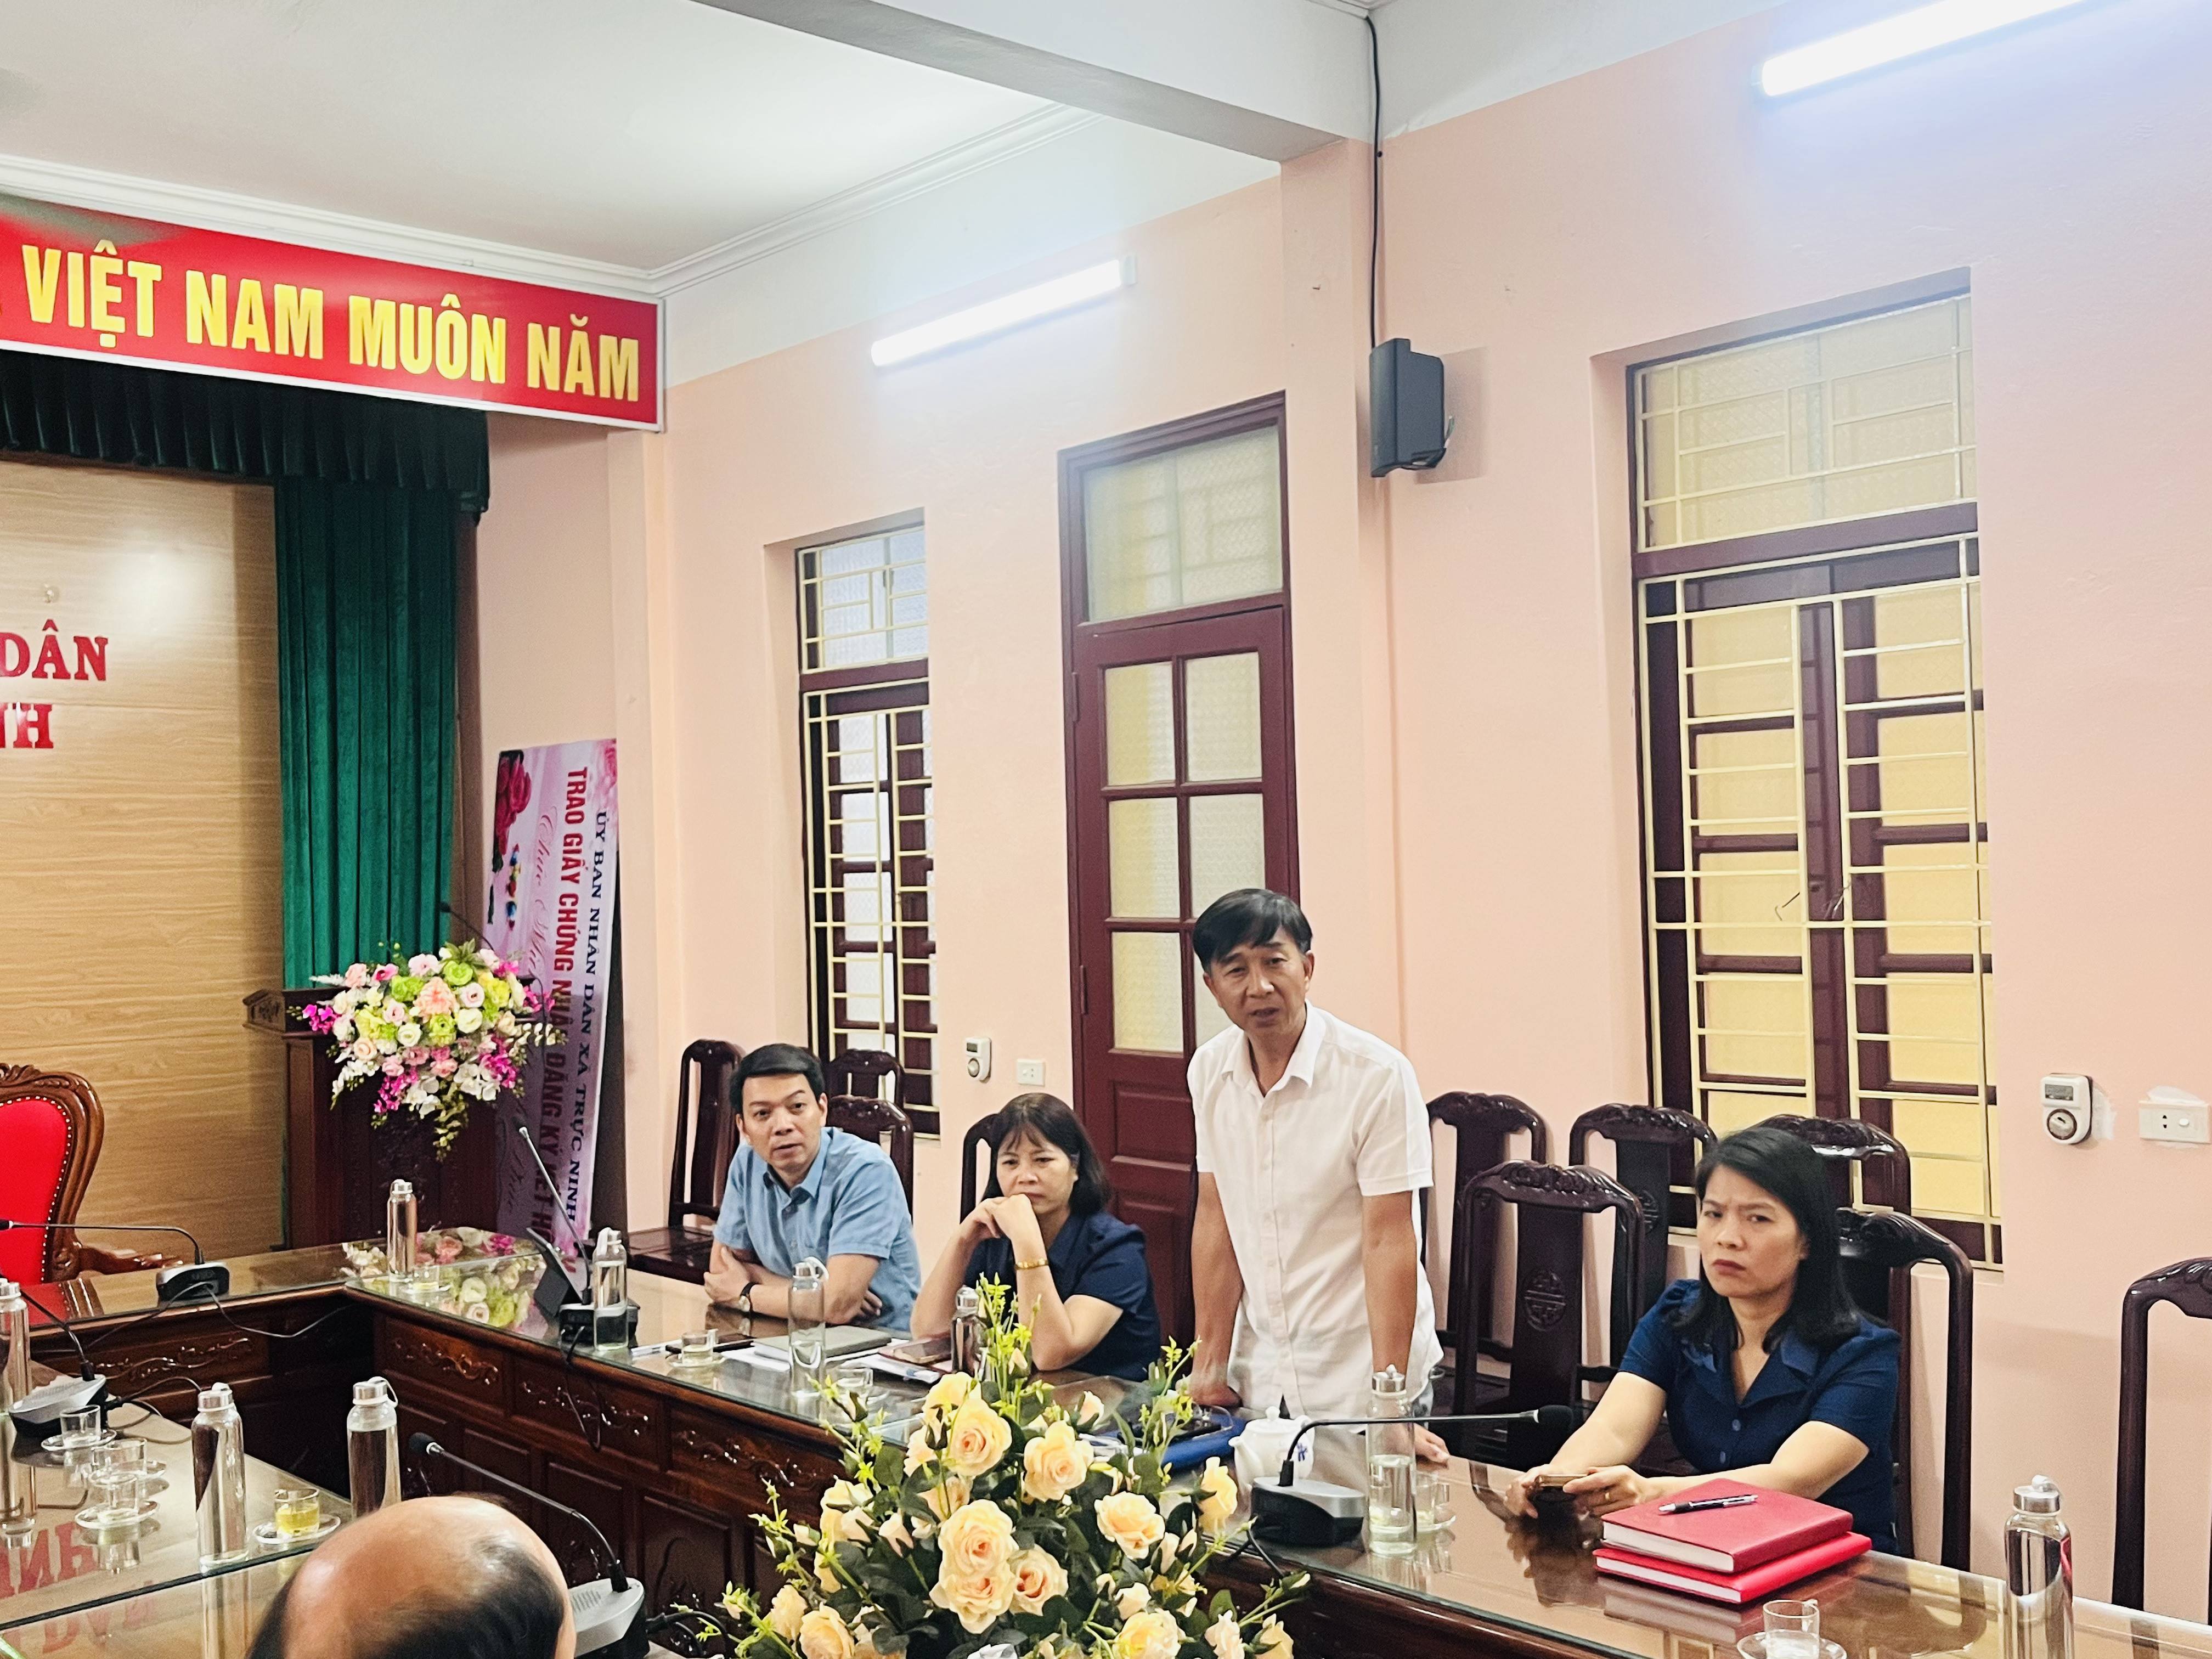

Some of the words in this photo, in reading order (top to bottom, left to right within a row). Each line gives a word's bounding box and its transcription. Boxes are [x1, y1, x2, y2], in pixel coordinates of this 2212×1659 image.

[21, 239, 162, 348] VIỆT
[185, 269, 324, 359] NAM
[348, 292, 506, 384] MUÔN
[527, 314, 639, 402] NĂM
[0, 619, 108, 681] DÂN
[0, 702, 54, 749] H
[565, 766, 588, 825] TRAO
[595, 811, 609, 843] ỦY
[561, 833, 589, 885] GIẤY
[591, 851, 605, 899] BAN
[554, 893, 581, 972] CHỨNG
[585, 908, 600, 975] NHÂN
[581, 984, 595, 1034] DÂN
[569, 1084, 587, 1152] TRỰC
[566, 1159, 580, 1221] NINH
